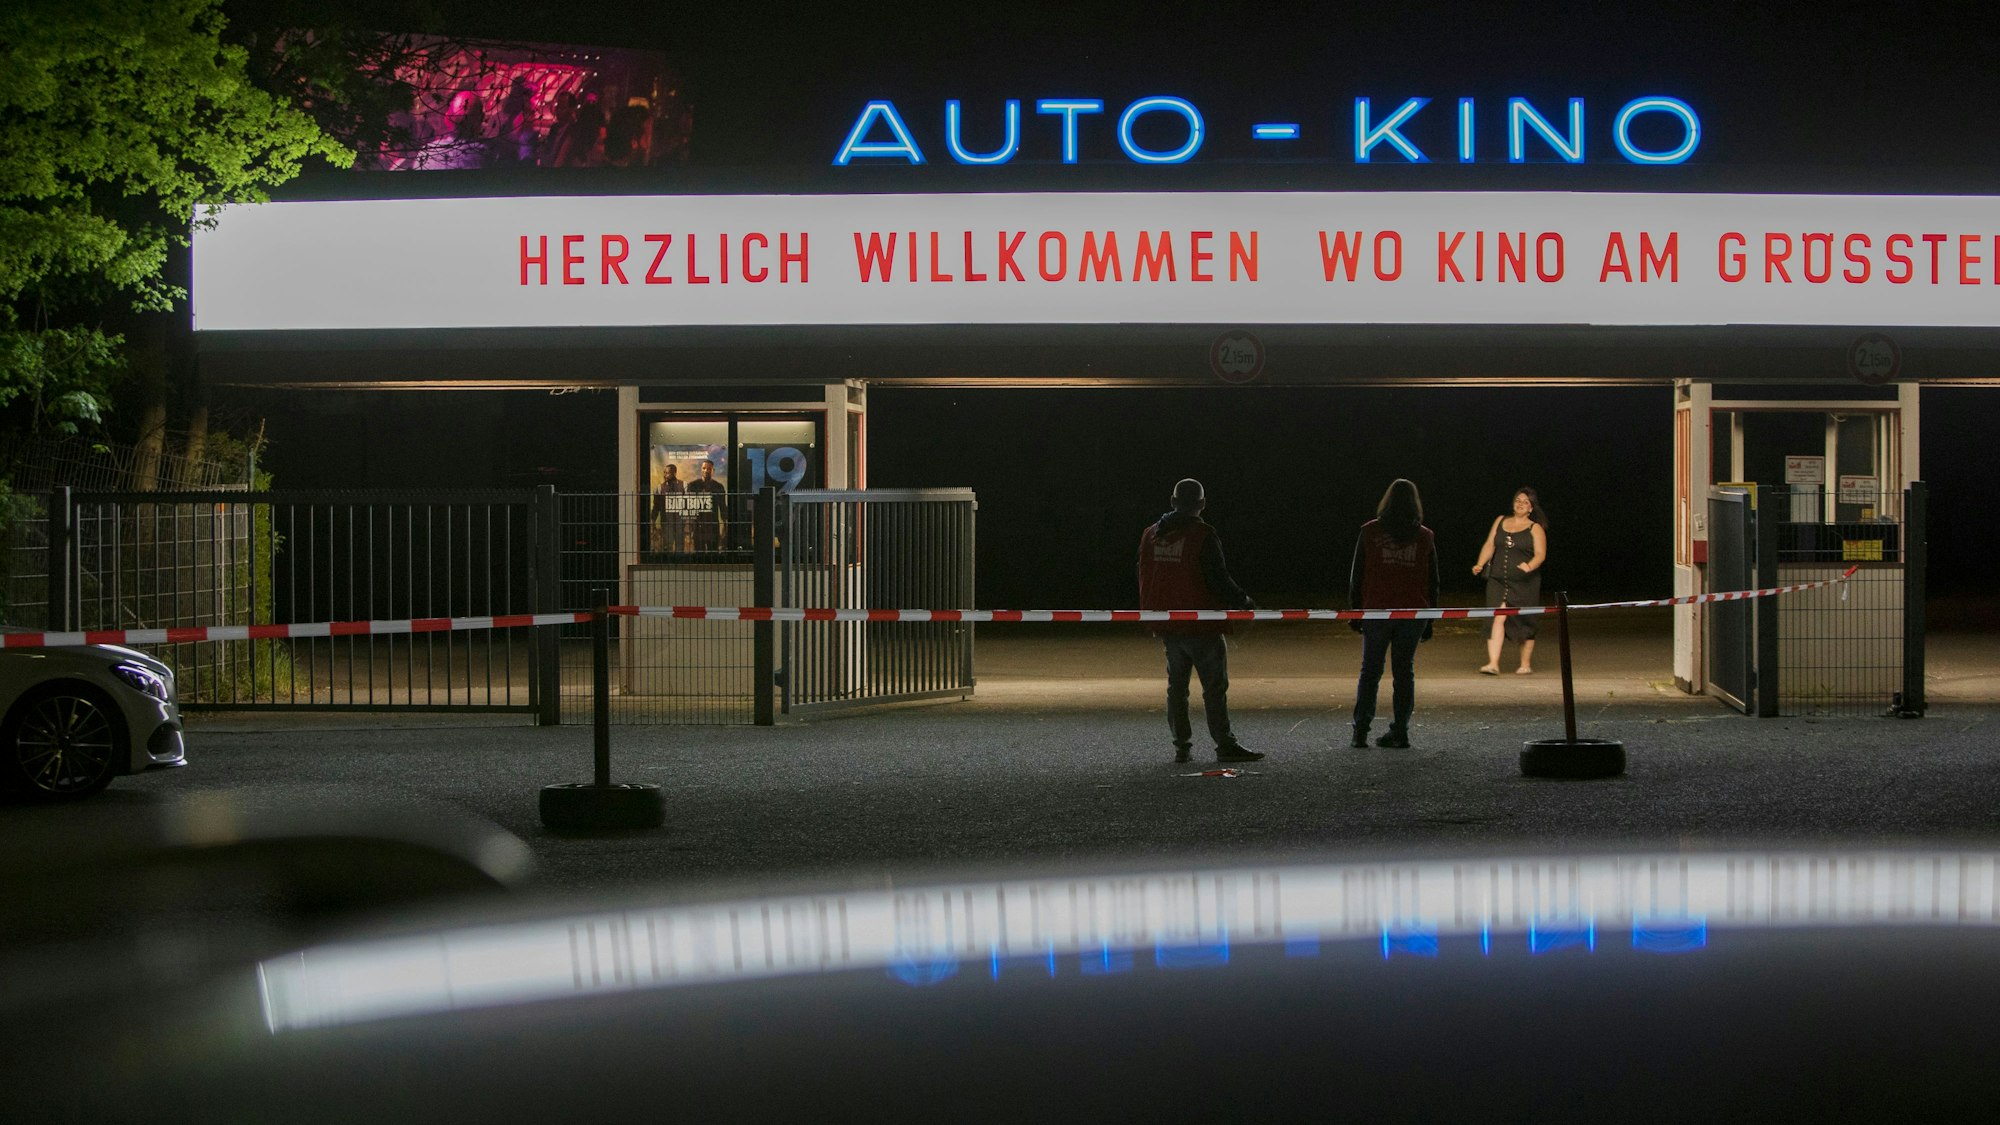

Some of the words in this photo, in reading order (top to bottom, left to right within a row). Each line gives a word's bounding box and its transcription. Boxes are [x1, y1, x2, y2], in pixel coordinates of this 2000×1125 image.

[832, 96, 1205, 166] AUTO
[1353, 95, 1702, 166] KINO
[520, 232, 808, 286] HERZLICH
[854, 231, 1258, 283] WILLKOMMEN
[1319, 230, 1402, 282] WO
[1438, 231, 1564, 283] KINO
[1600, 232, 1678, 282] AM
[1718, 232, 2000, 285] GRÖSSTE
[746, 446, 807, 496] 19
[666, 496, 686, 513] BAD
[687, 496, 713, 513] BOYS
